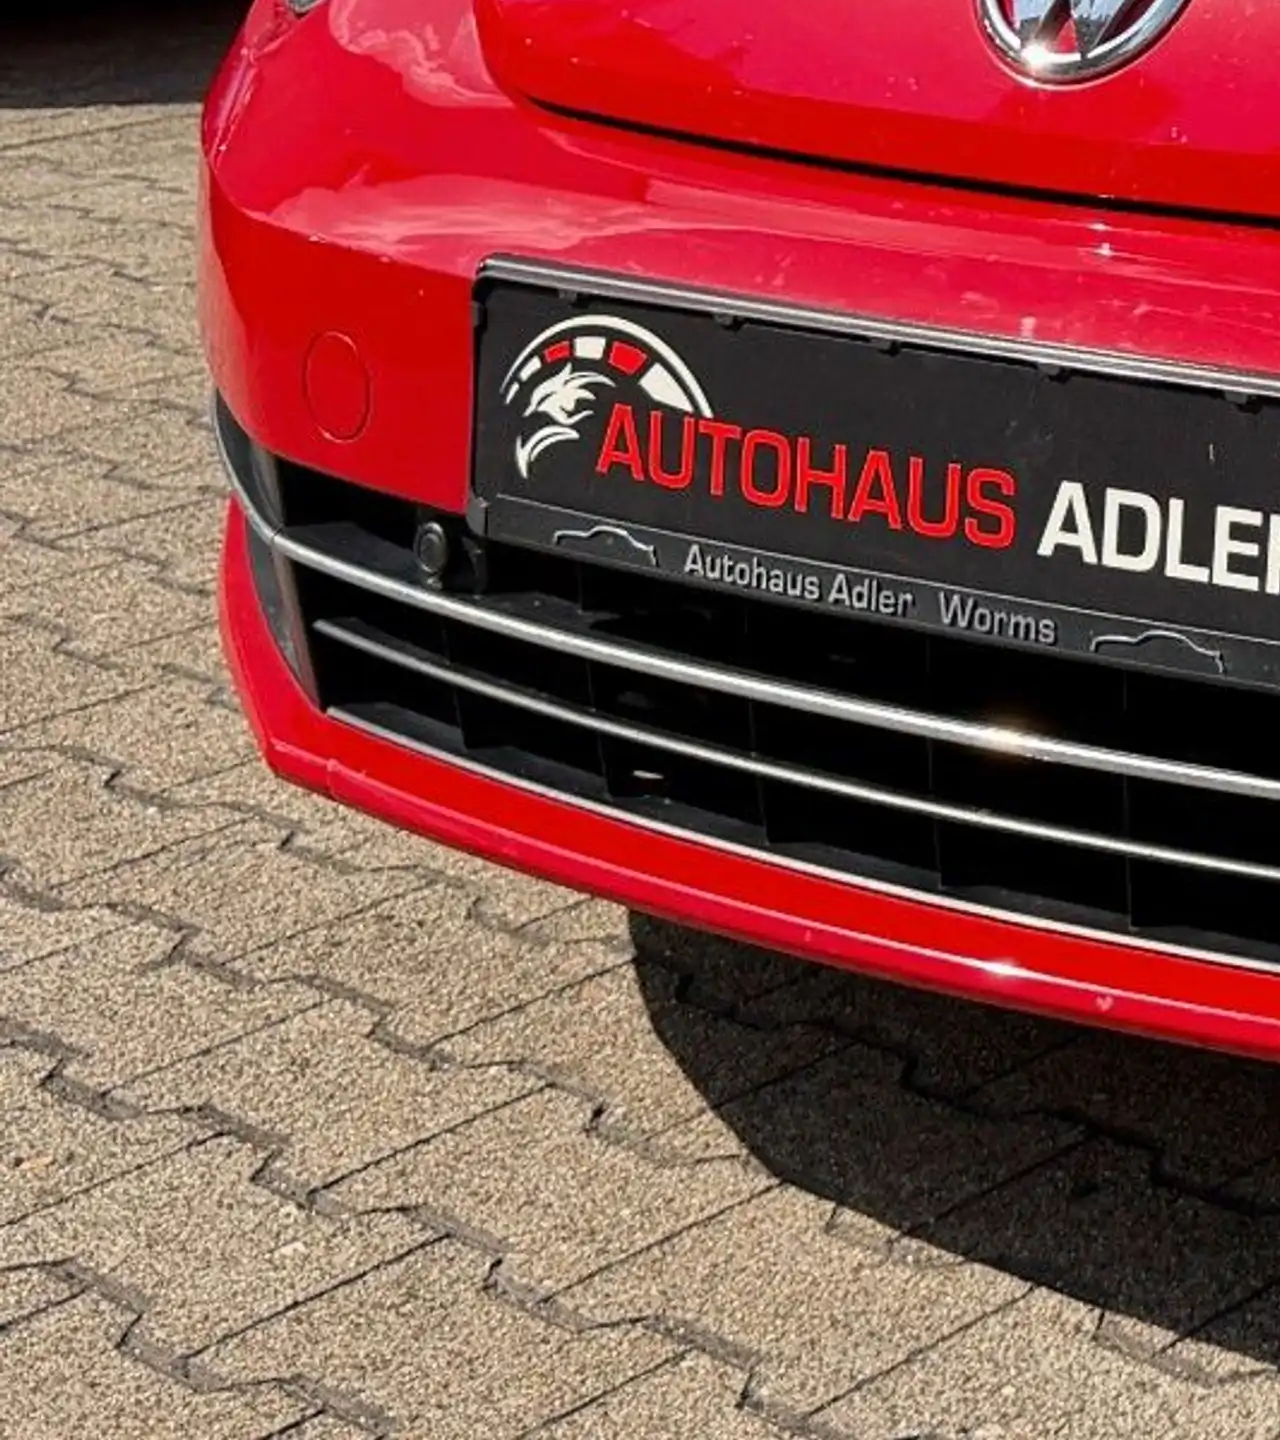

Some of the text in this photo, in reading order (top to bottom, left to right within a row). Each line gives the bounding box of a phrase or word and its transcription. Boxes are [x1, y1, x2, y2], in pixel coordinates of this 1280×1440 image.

[595, 402, 1017, 549] AUTOHAUS
[684, 543, 1056, 644] Autohaus Adler Worms
